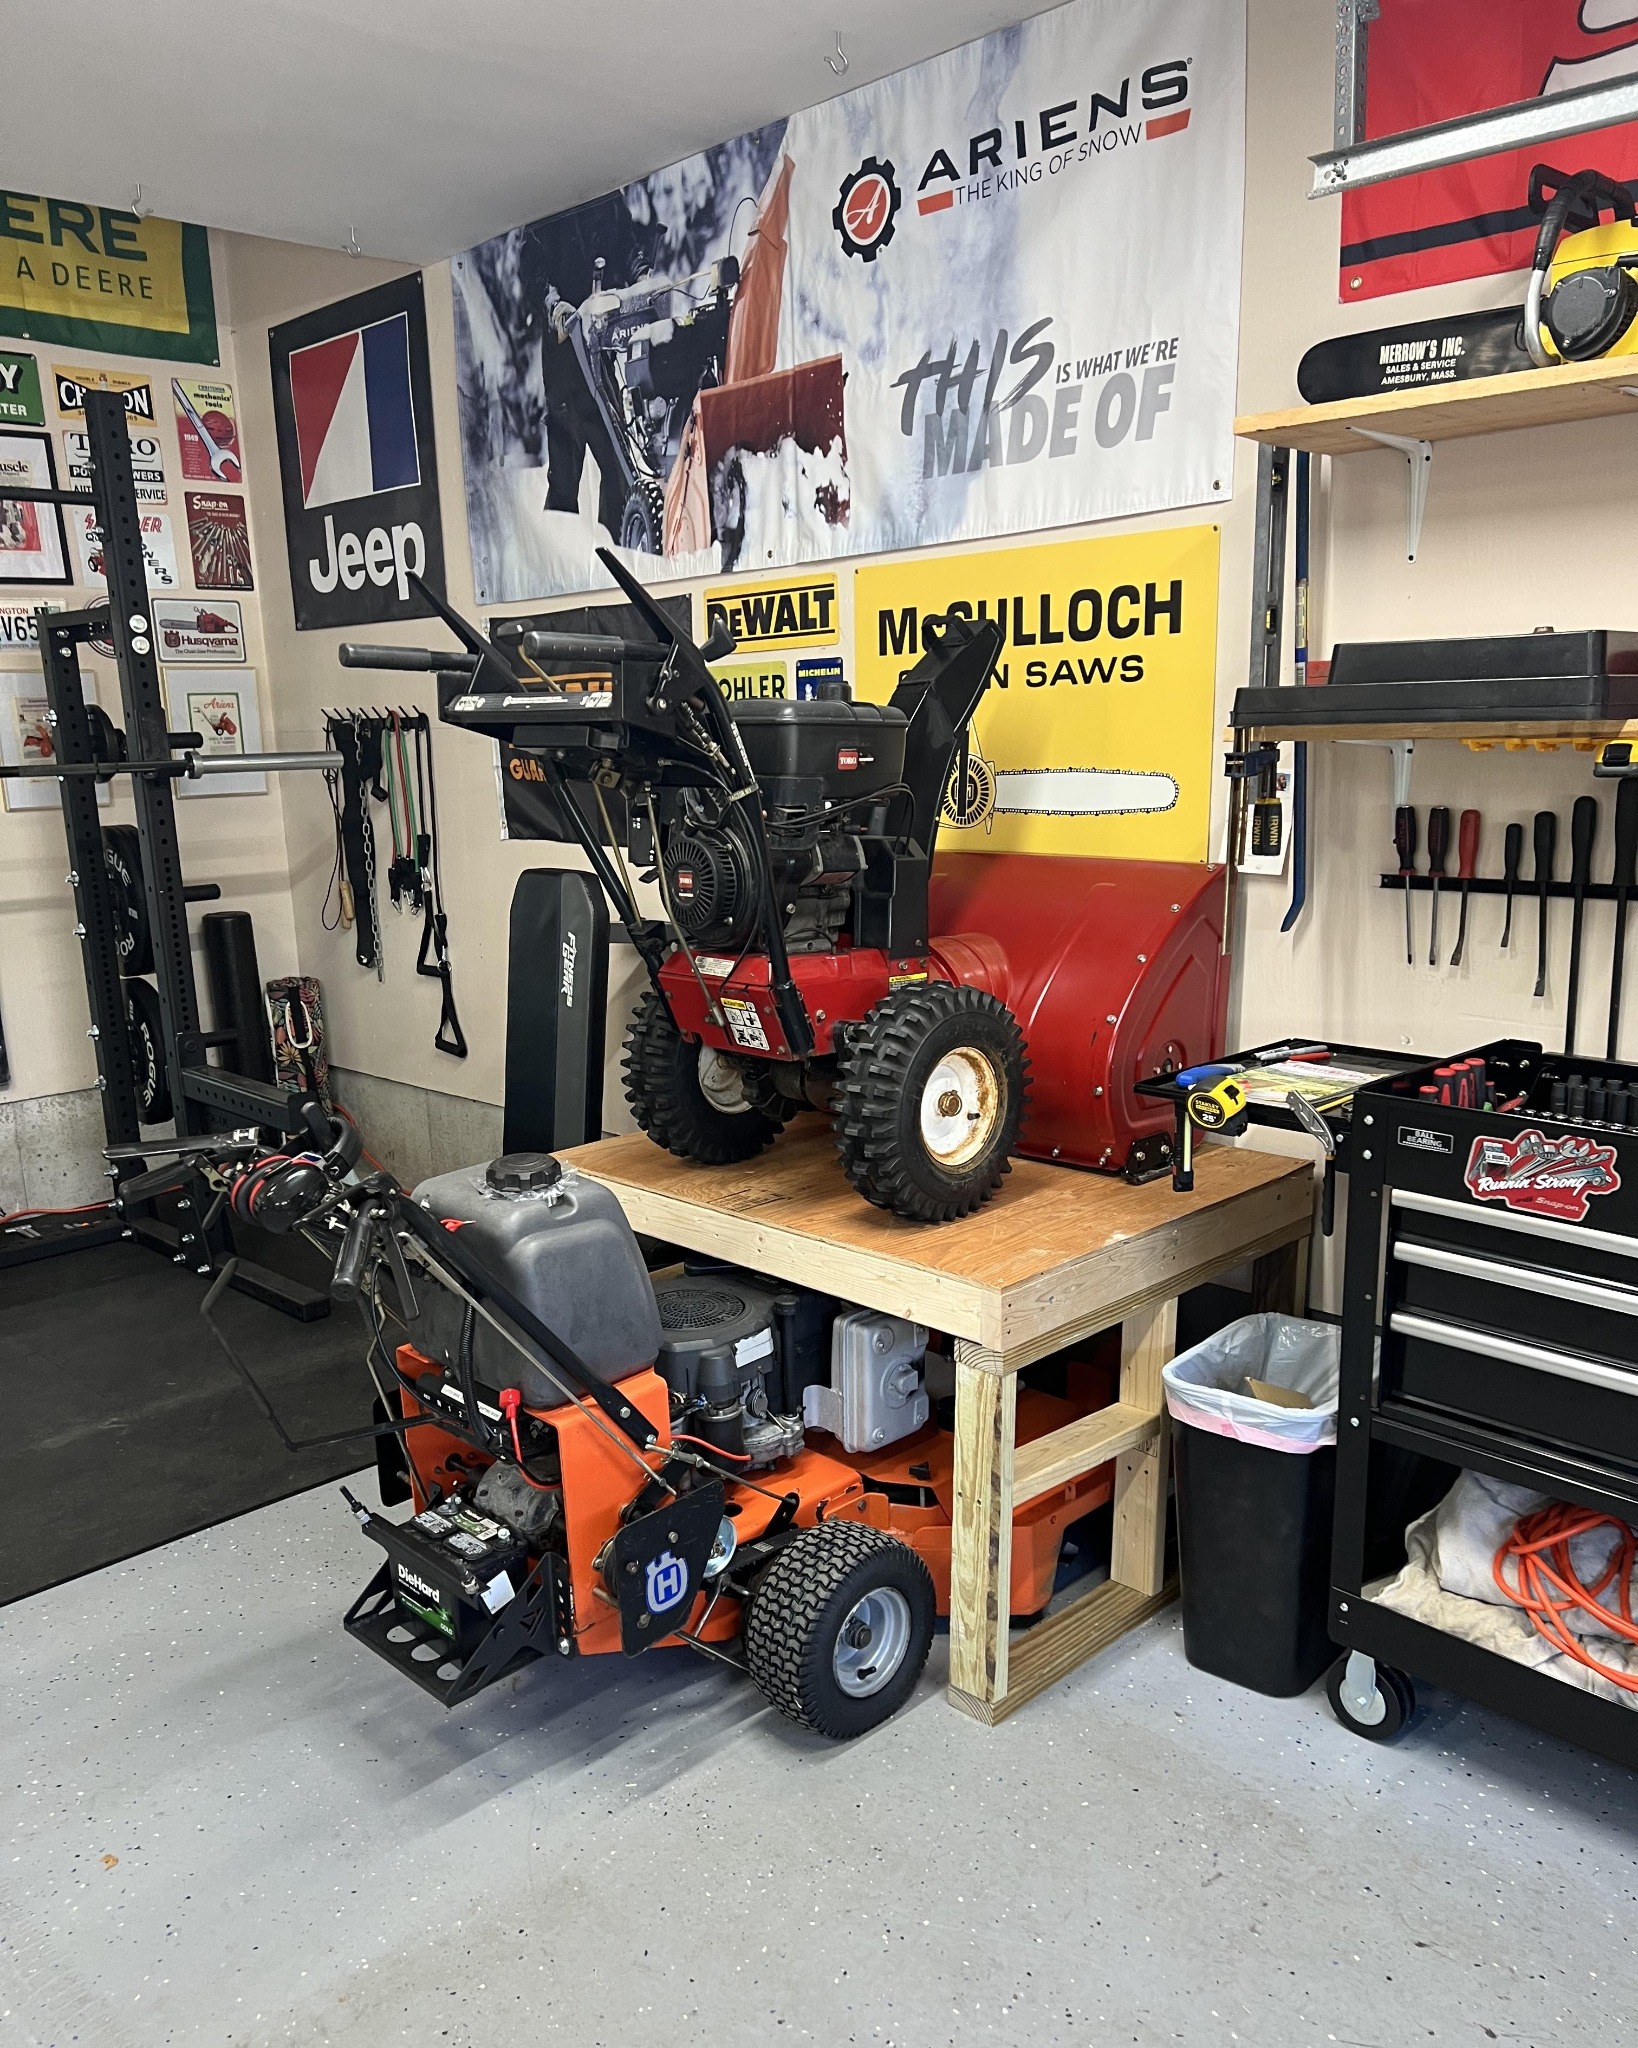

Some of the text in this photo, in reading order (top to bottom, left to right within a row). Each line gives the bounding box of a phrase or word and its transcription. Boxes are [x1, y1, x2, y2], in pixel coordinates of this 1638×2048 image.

[918, 60, 1188, 191] ARIENS
[956, 122, 1142, 205] THE KING OF SNOW
[17, 256, 153, 300] A DEERE
[1379, 336, 1466, 365] MERROW'S INC.
[890, 317, 1179, 437] THIS IS WHAT WE'RE
[1380, 370, 1457, 386] AMESBURY, MASS.
[1385, 358, 1457, 374] SALES & SERVICE
[0, 402, 27, 417] TER
[923, 363, 1176, 480] MADE OF
[136, 488, 166, 500] ERVICE
[193, 495, 229, 510] Snap-on
[309, 515, 426, 601] Jeep
[181, 635, 238, 647] Husqvarna
[798, 667, 841, 678] MICHELIN
[1026, 654, 1144, 688] SAWS
[718, 674, 785, 702] OHLER
[1253, 815, 1262, 845] IRWIN
[1269, 815, 1279, 846] IRWIN
[140, 1021, 156, 1107] ROGUE
[1406, 1135, 1443, 1148] BEARING
[1415, 1130, 1435, 1140] BALL
[1477, 1174, 1588, 1197] Runnin' Strong
[397, 1563, 440, 1604] DieHard
